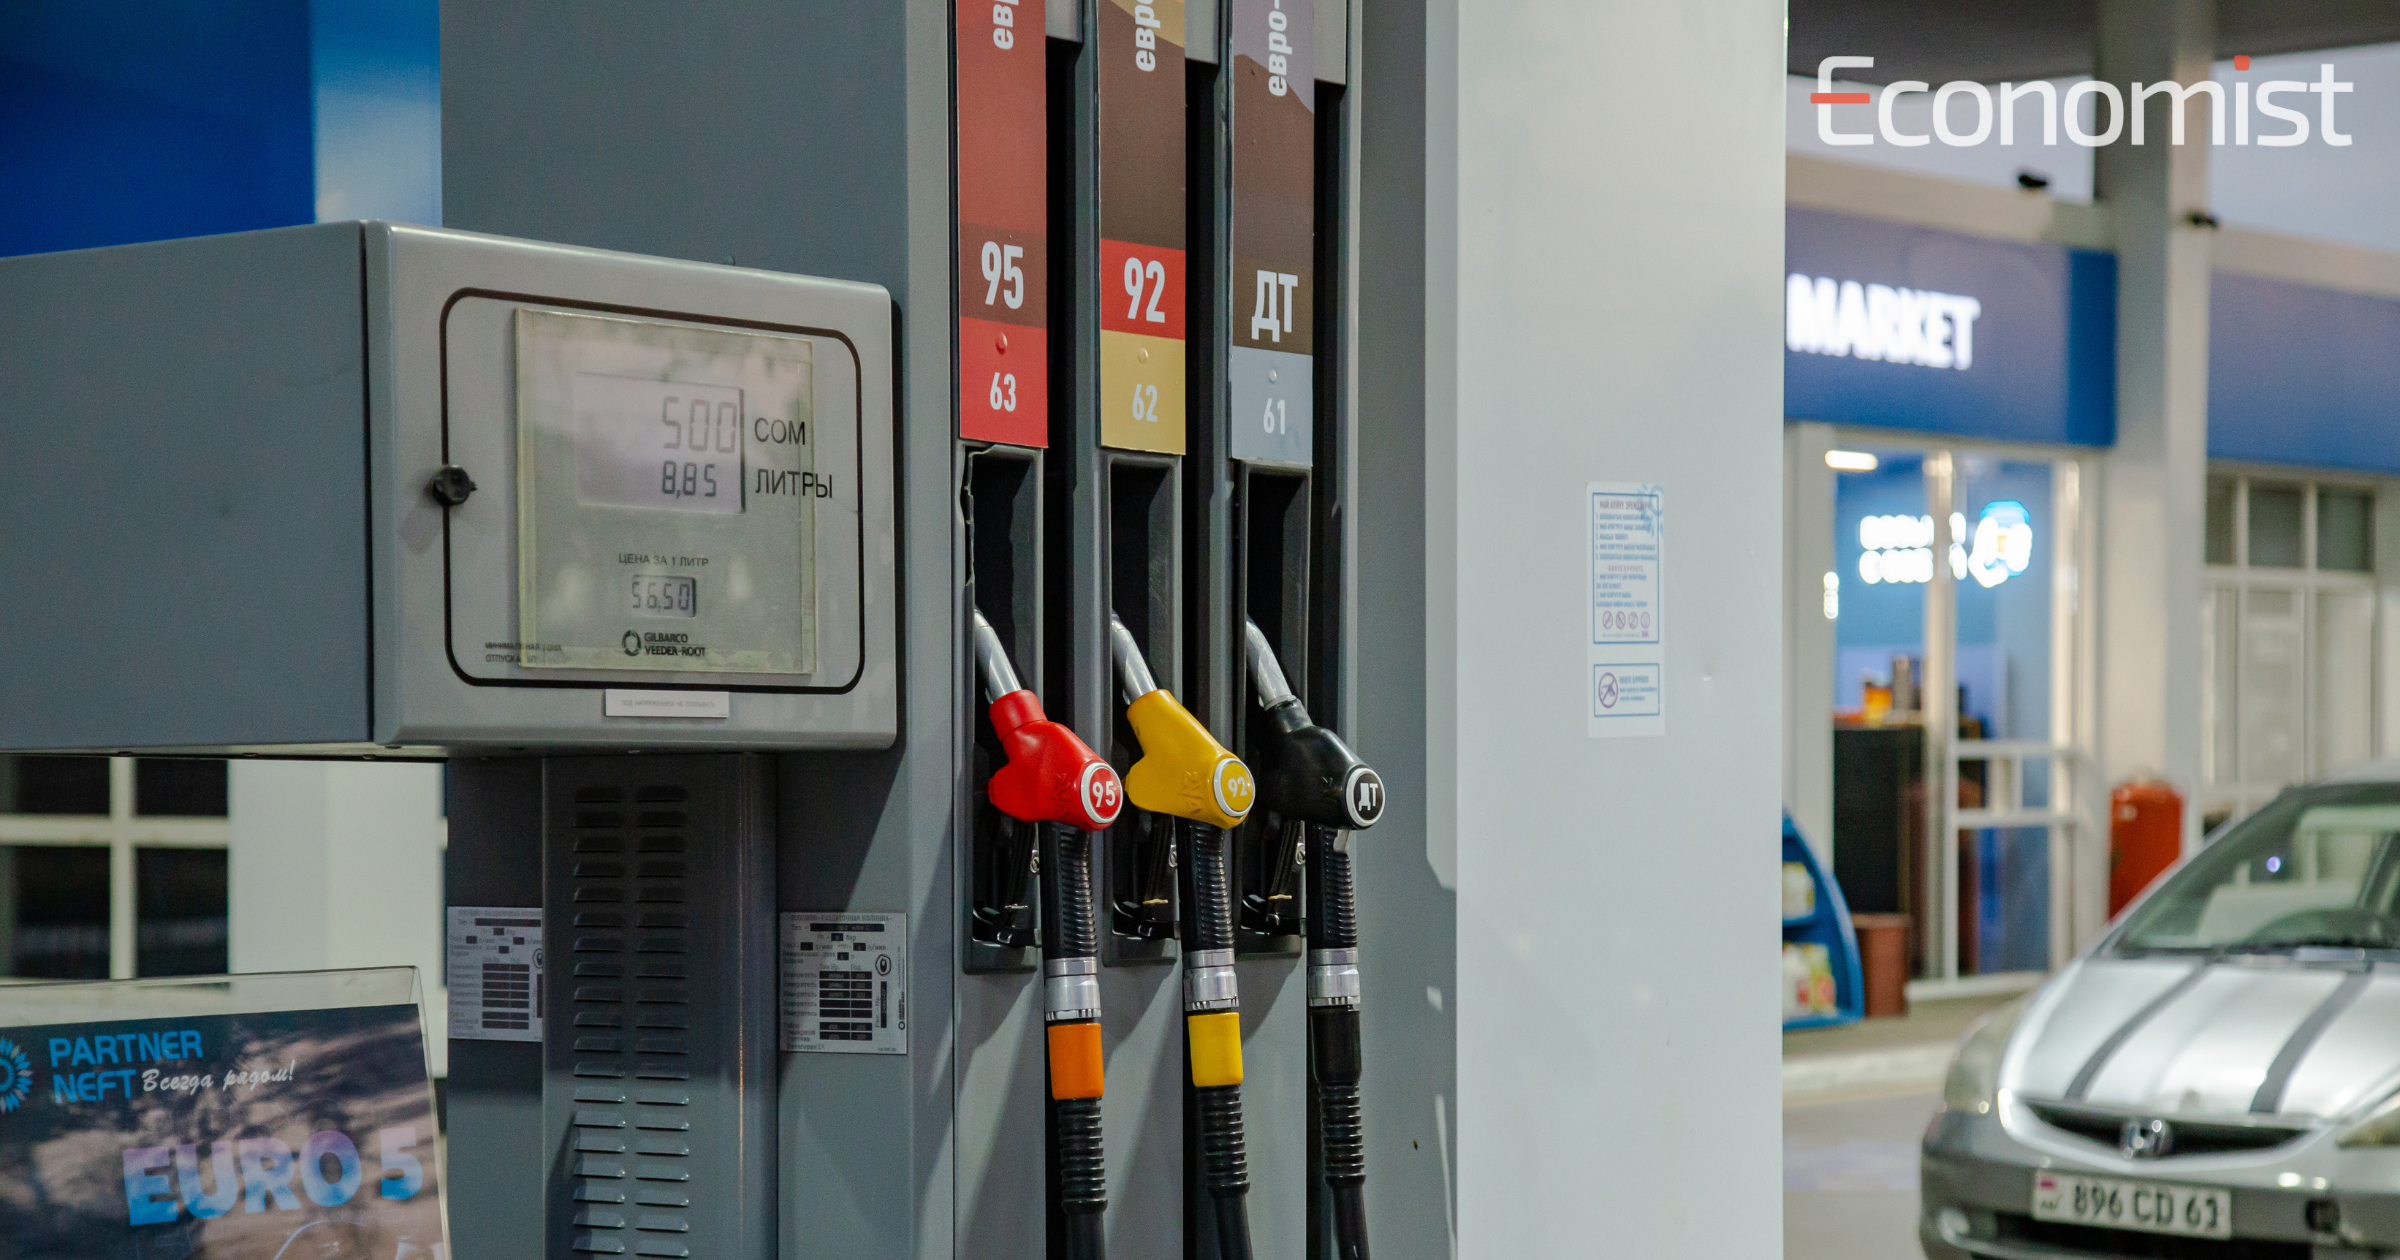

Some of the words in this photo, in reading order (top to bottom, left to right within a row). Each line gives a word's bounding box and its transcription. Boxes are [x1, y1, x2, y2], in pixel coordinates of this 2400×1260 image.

[993, 0, 1019, 50] ев
[1134, 0, 1161, 72] евр
[981, 241, 1024, 309] 95
[1123, 256, 1166, 323] 92
[1251, 270, 1298, 342] ДТ
[1786, 273, 1981, 371] MARKET
[990, 372, 1017, 412] 63
[1132, 384, 1158, 422] 62
[661, 396, 738, 454] 500
[754, 418, 806, 446] СОМ
[1262, 398, 1286, 435] 61
[755, 468, 833, 499] ЛИТРЫ
[618, 553, 650, 565] ЦЕНА
[653, 555, 668, 565] ЗА
[671, 557, 677, 566] 1
[679, 557, 709, 567] ЛИТР
[644, 632, 688, 643] GILBARCO
[644, 646, 706, 656] VEEDER-ROOT
[1092, 780, 1117, 808] 95
[1227, 775, 1248, 798] 92
[1358, 782, 1379, 812] ДТ
[49, 1030, 203, 1068] PARTNER
[53, 1069, 137, 1104] NEFT
[141, 1068, 214, 1096] Всегда
[222, 1059, 296, 1092] рядом!
[122, 1130, 362, 1227] EURO
[380, 1126, 424, 1200] 5
[2074, 1184, 2122, 1219] 896
[2134, 1189, 2174, 1224] CD
